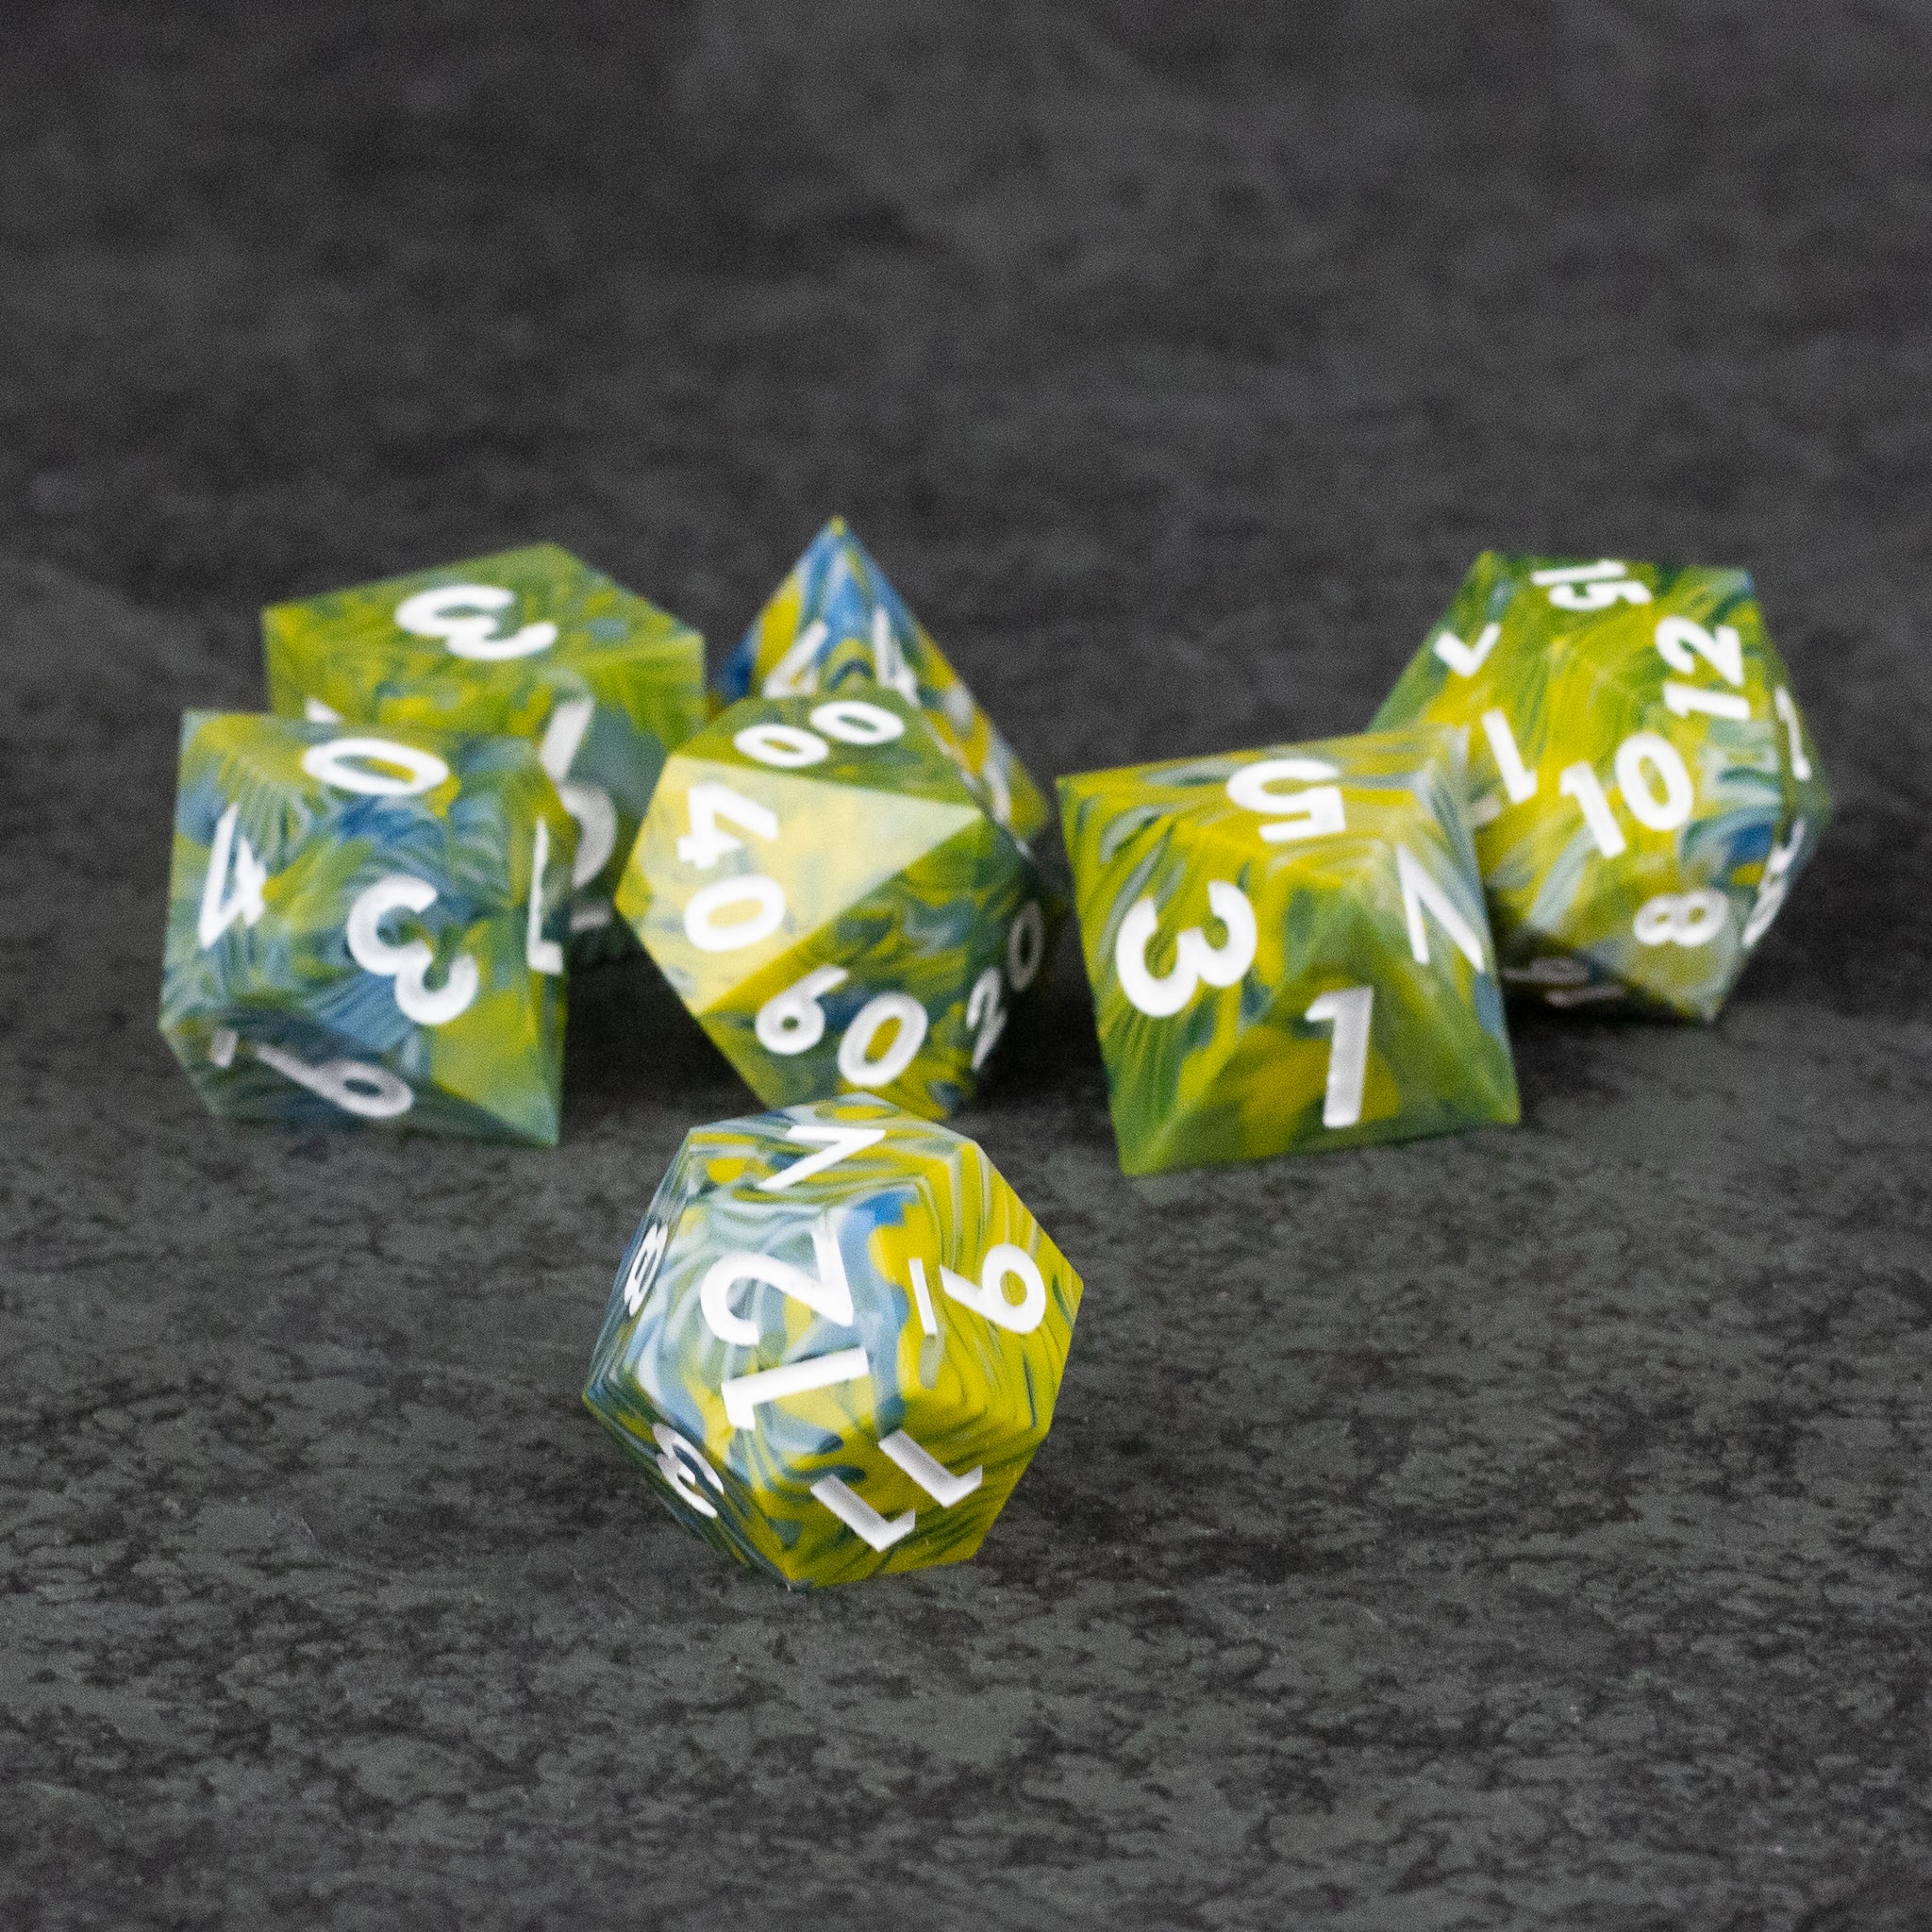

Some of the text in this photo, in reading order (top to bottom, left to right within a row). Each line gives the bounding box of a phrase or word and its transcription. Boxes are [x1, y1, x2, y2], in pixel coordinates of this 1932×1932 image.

[395, 583, 558, 660] 3
[1654, 614, 1751, 721] 12
[302, 739, 449, 795] 0
[732, 699, 906, 768] 00
[1559, 731, 1695, 860] 10
[1226, 759, 1346, 842] 5
[198, 803, 266, 949] 4
[676, 780, 787, 953] 40
[1633, 889, 1729, 946] 8
[347, 875, 479, 1025] 3
[1115, 879, 1257, 1019] 3
[1305, 984, 1374, 1130] 1
[758, 1125, 887, 1192] 7
[700, 1225, 871, 1432] 12
[810, 1430, 984, 1554] 11
